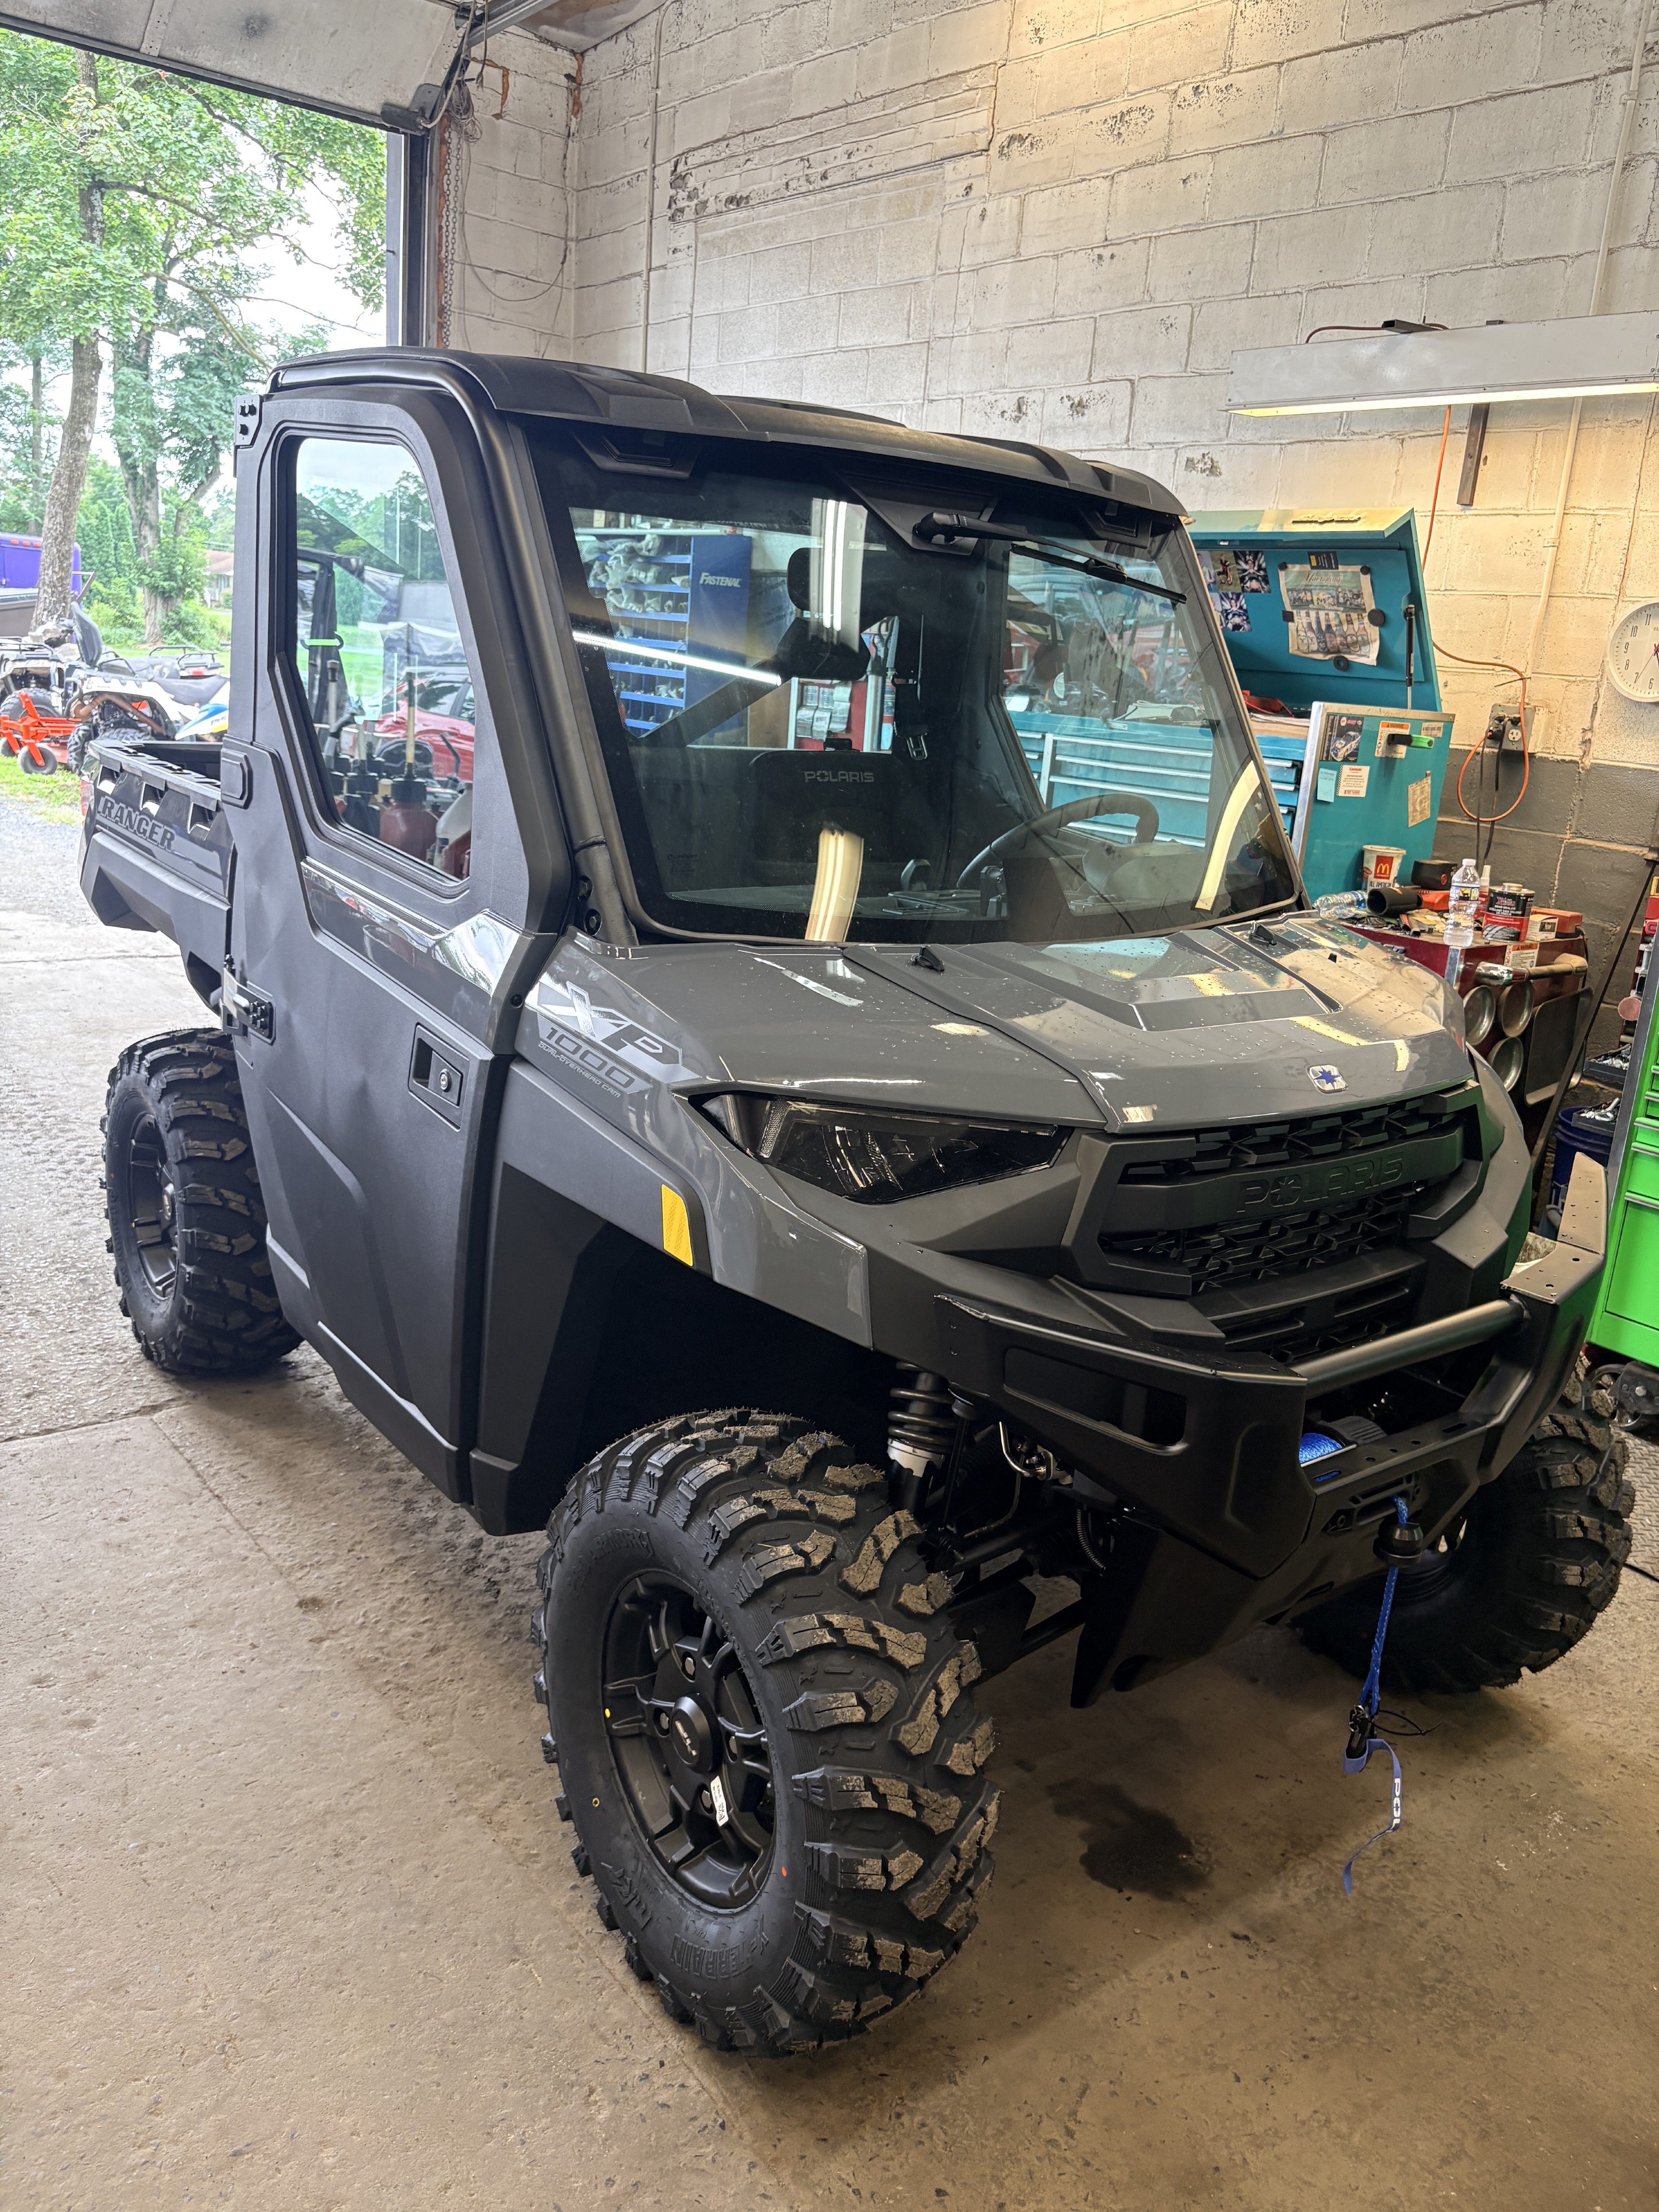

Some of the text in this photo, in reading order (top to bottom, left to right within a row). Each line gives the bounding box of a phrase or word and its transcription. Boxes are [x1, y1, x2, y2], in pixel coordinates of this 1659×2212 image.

[699, 572, 742, 587] FASTENAL
[1306, 572, 1343, 584] Yuengling
[1645, 614, 1651, 625] 11
[1630, 626, 1638, 637] 10
[1624, 642, 1629, 653] 9
[1624, 659, 1630, 670] 8
[1634, 672, 1639, 683] 7
[1649, 678, 1654, 689] 6
[804, 771, 874, 783] POLARIS
[100, 796, 176, 852] RANGER
[539, 981, 682, 1065] XP
[546, 1027, 635, 1089] 1000
[538, 1043, 621, 1098] DUAL-OVERHEAD CAM
[1237, 1153, 1403, 1213] POLARIS
